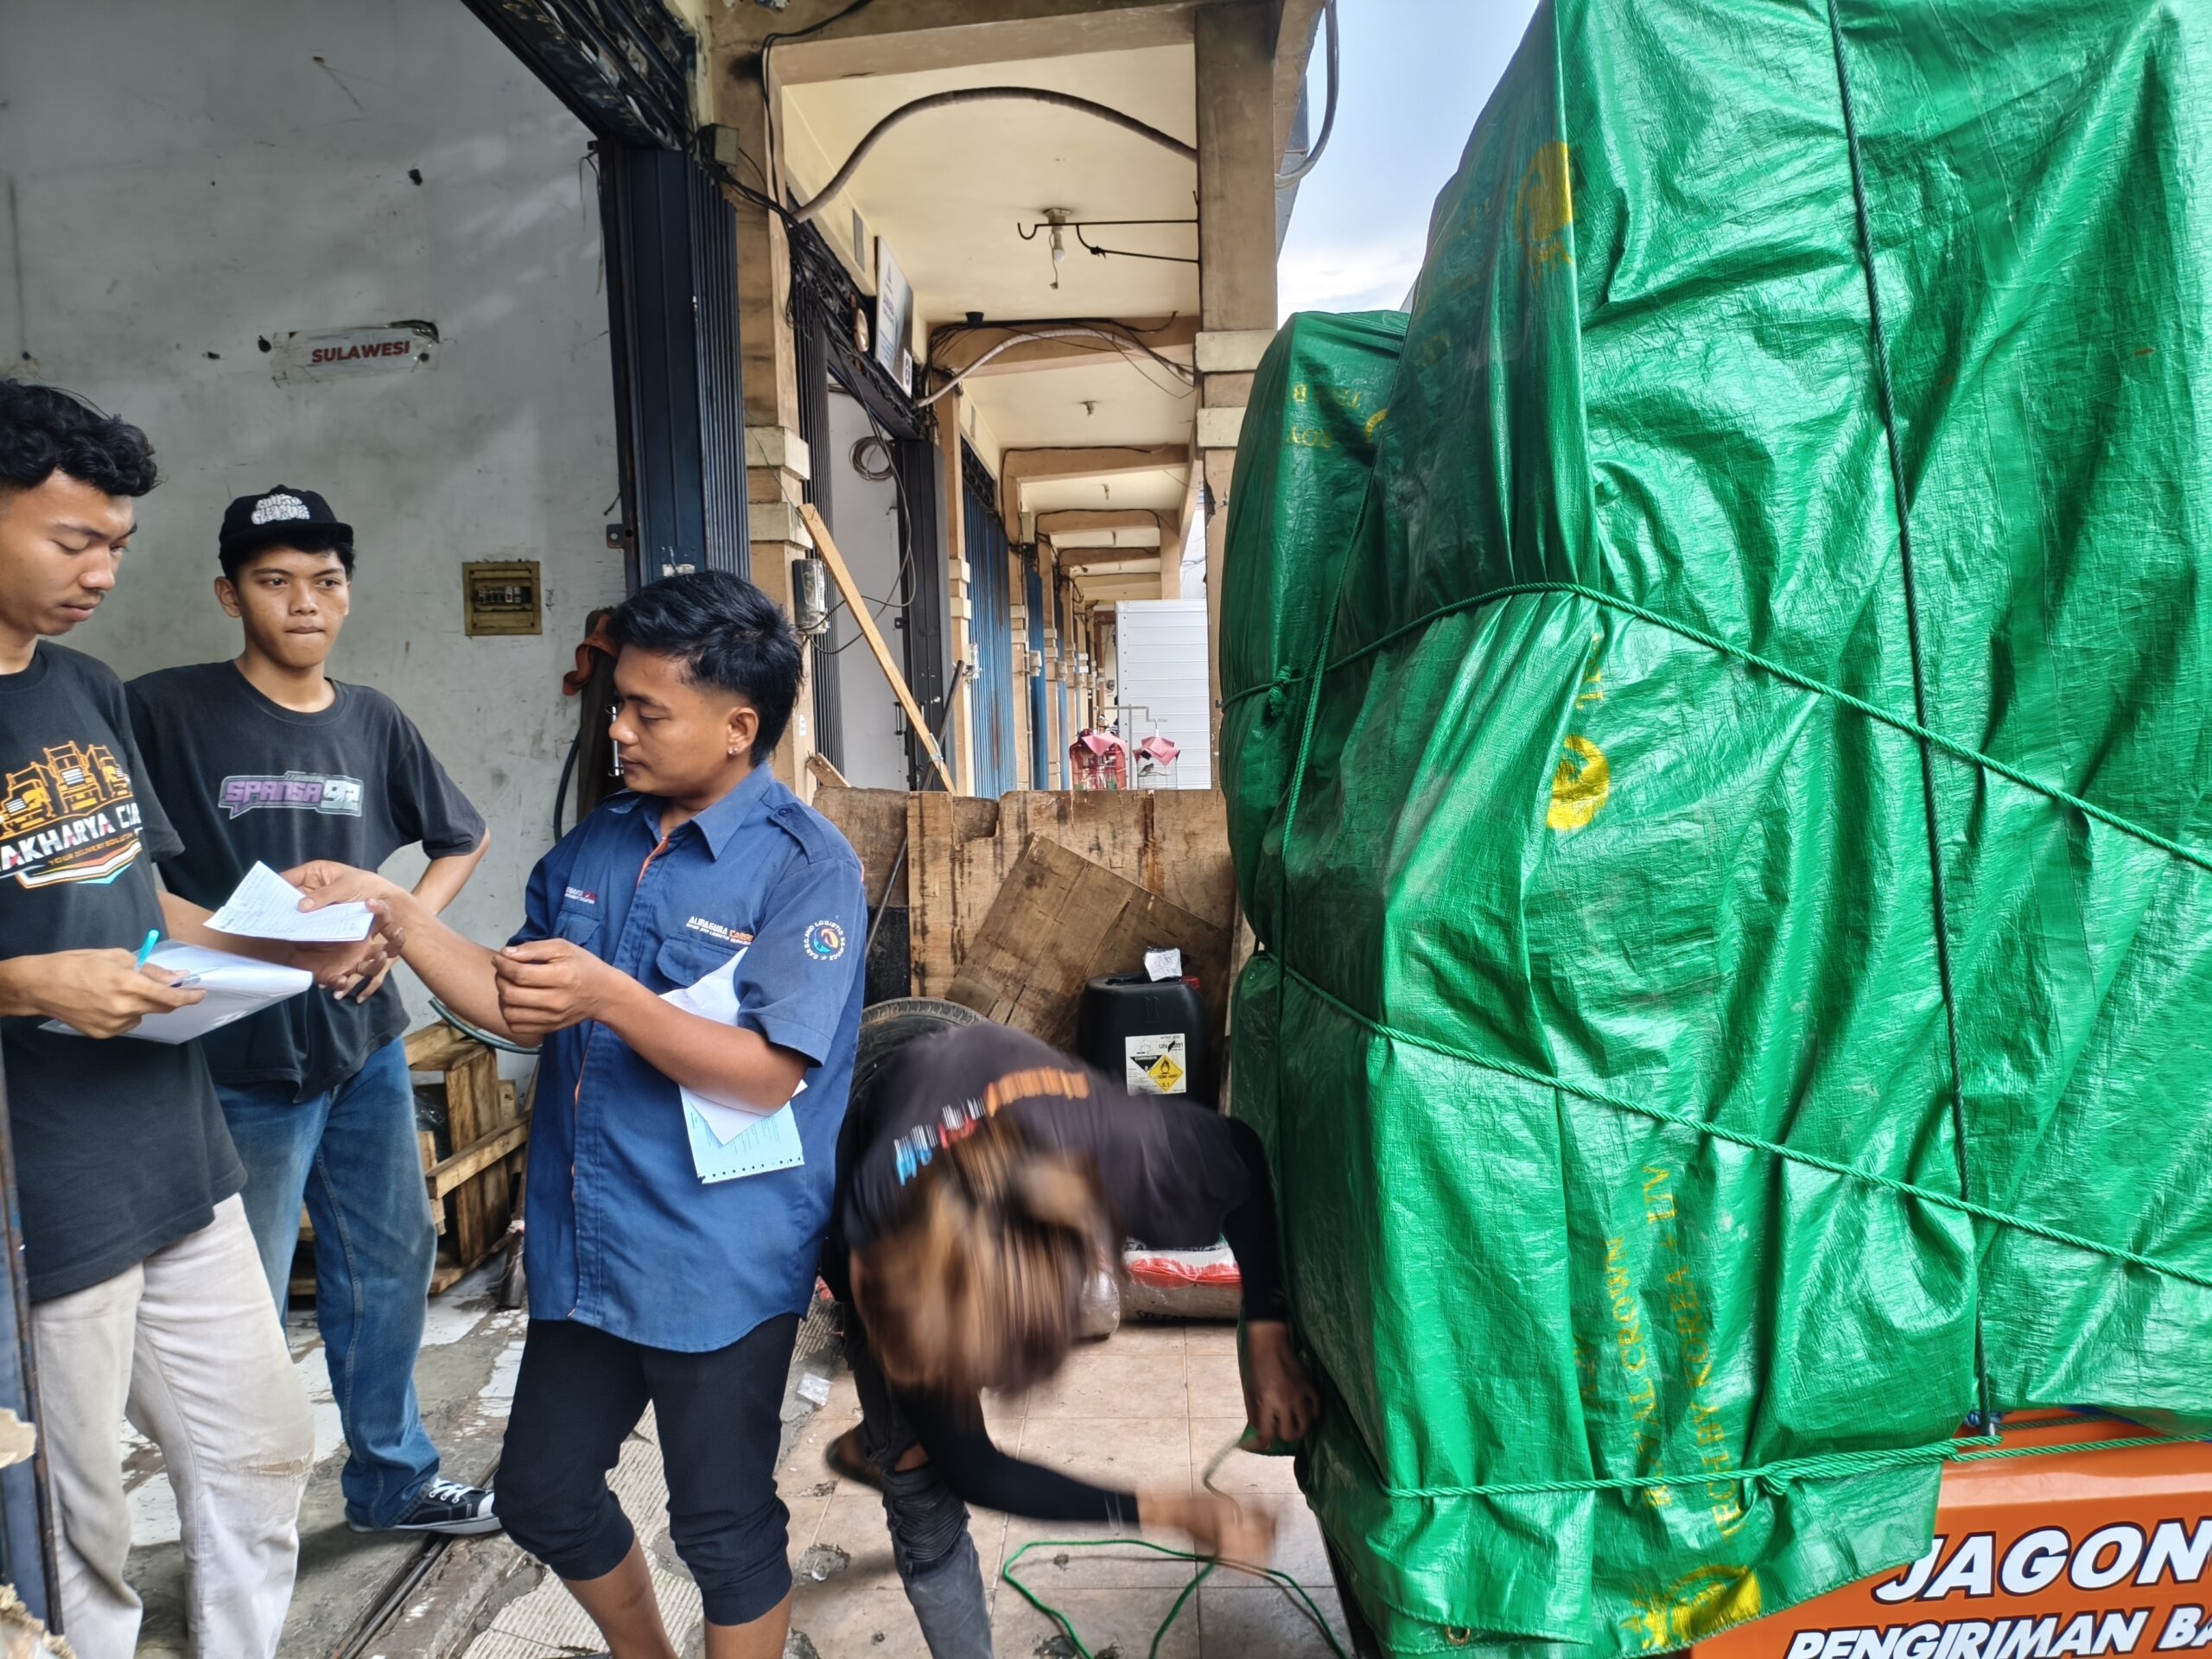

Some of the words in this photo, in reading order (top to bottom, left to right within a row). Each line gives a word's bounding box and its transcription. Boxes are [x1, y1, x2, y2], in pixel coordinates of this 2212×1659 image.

[312, 340, 410, 363] SULAWESI
[0, 812, 116, 872] AKHARYA
[1604, 1236, 1646, 1371] CROWN
[1665, 1265, 1713, 1389] KOREA
[1690, 1401, 1726, 1446] BY
[1871, 1516, 2212, 1605] JAGON
[1785, 1605, 2156, 1659] PENGIRIMAN
